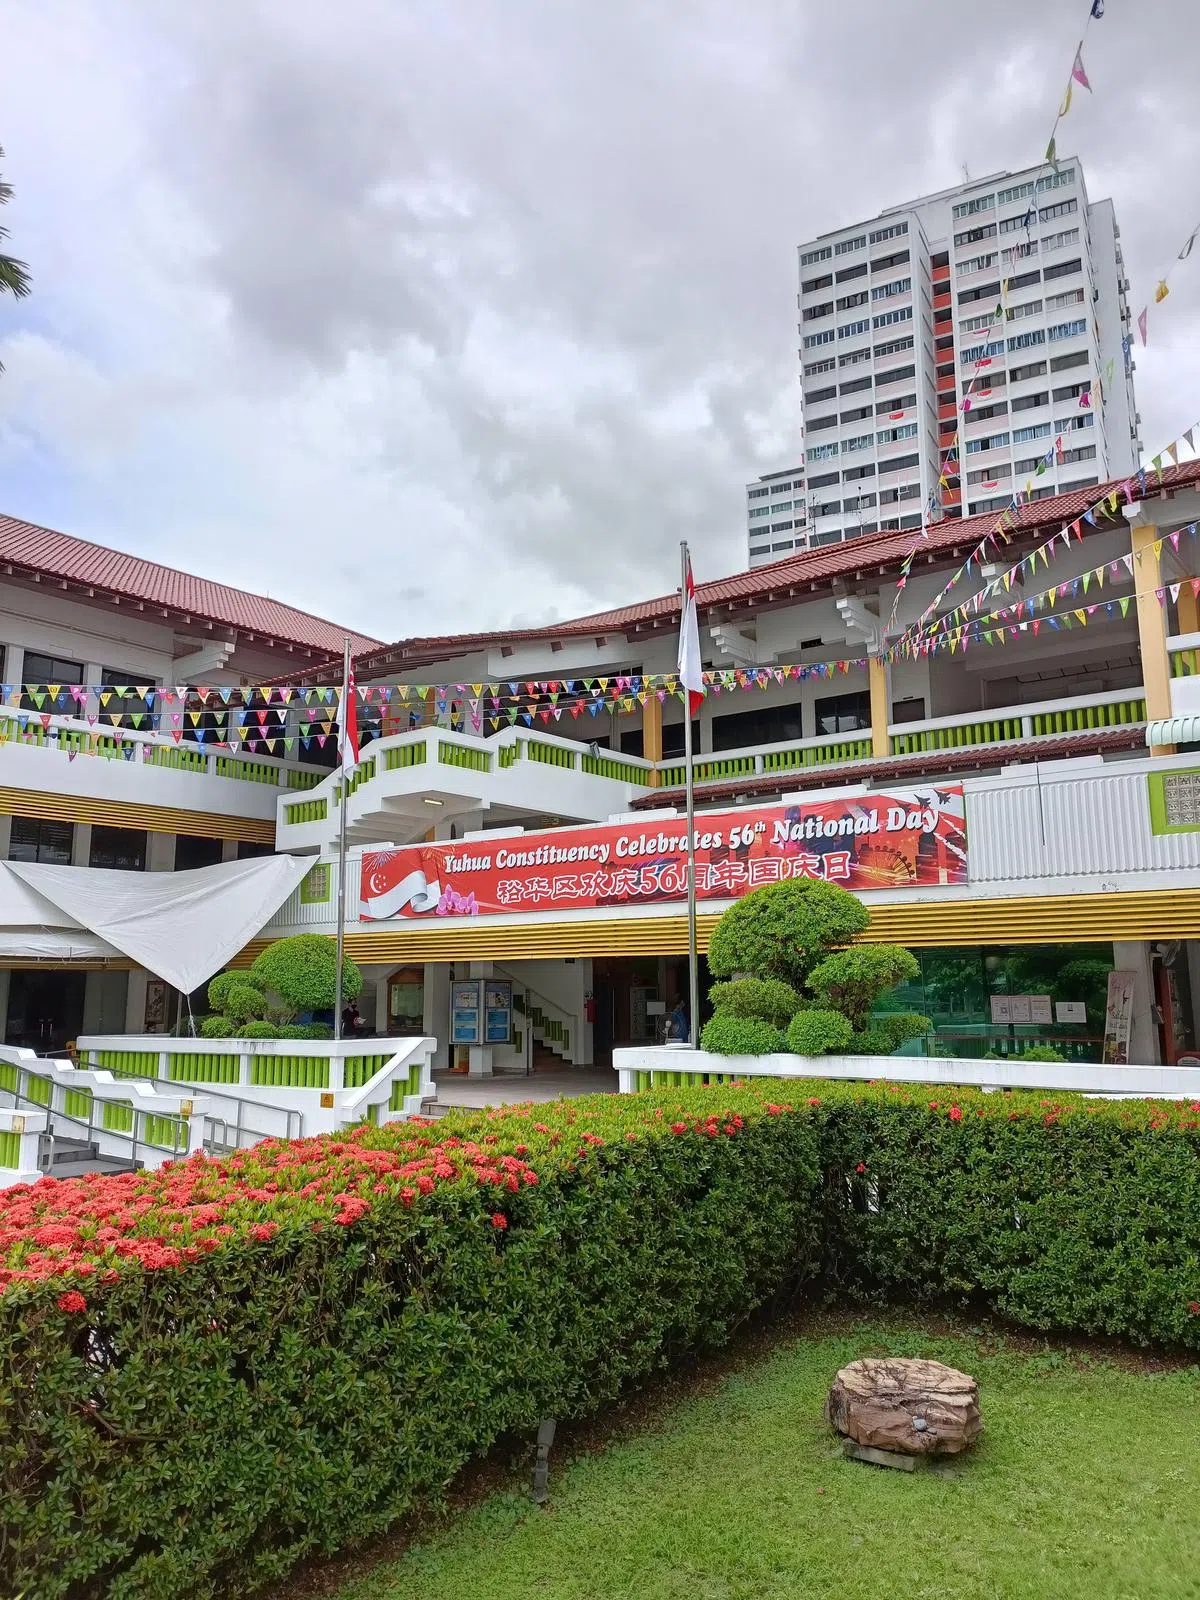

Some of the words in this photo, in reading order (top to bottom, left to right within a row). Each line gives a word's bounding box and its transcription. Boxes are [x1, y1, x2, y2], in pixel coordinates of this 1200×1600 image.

[443, 854, 491, 874] Yuhua
[496, 843, 609, 870] Constituency
[616, 830, 722, 856] Celebrates
[729, 821, 767, 849] 56th
[773, 808, 879, 843] National
[886, 806, 938, 833] Day
[497, 851, 851, 903] 裕华区欢庆56周年国庆日
